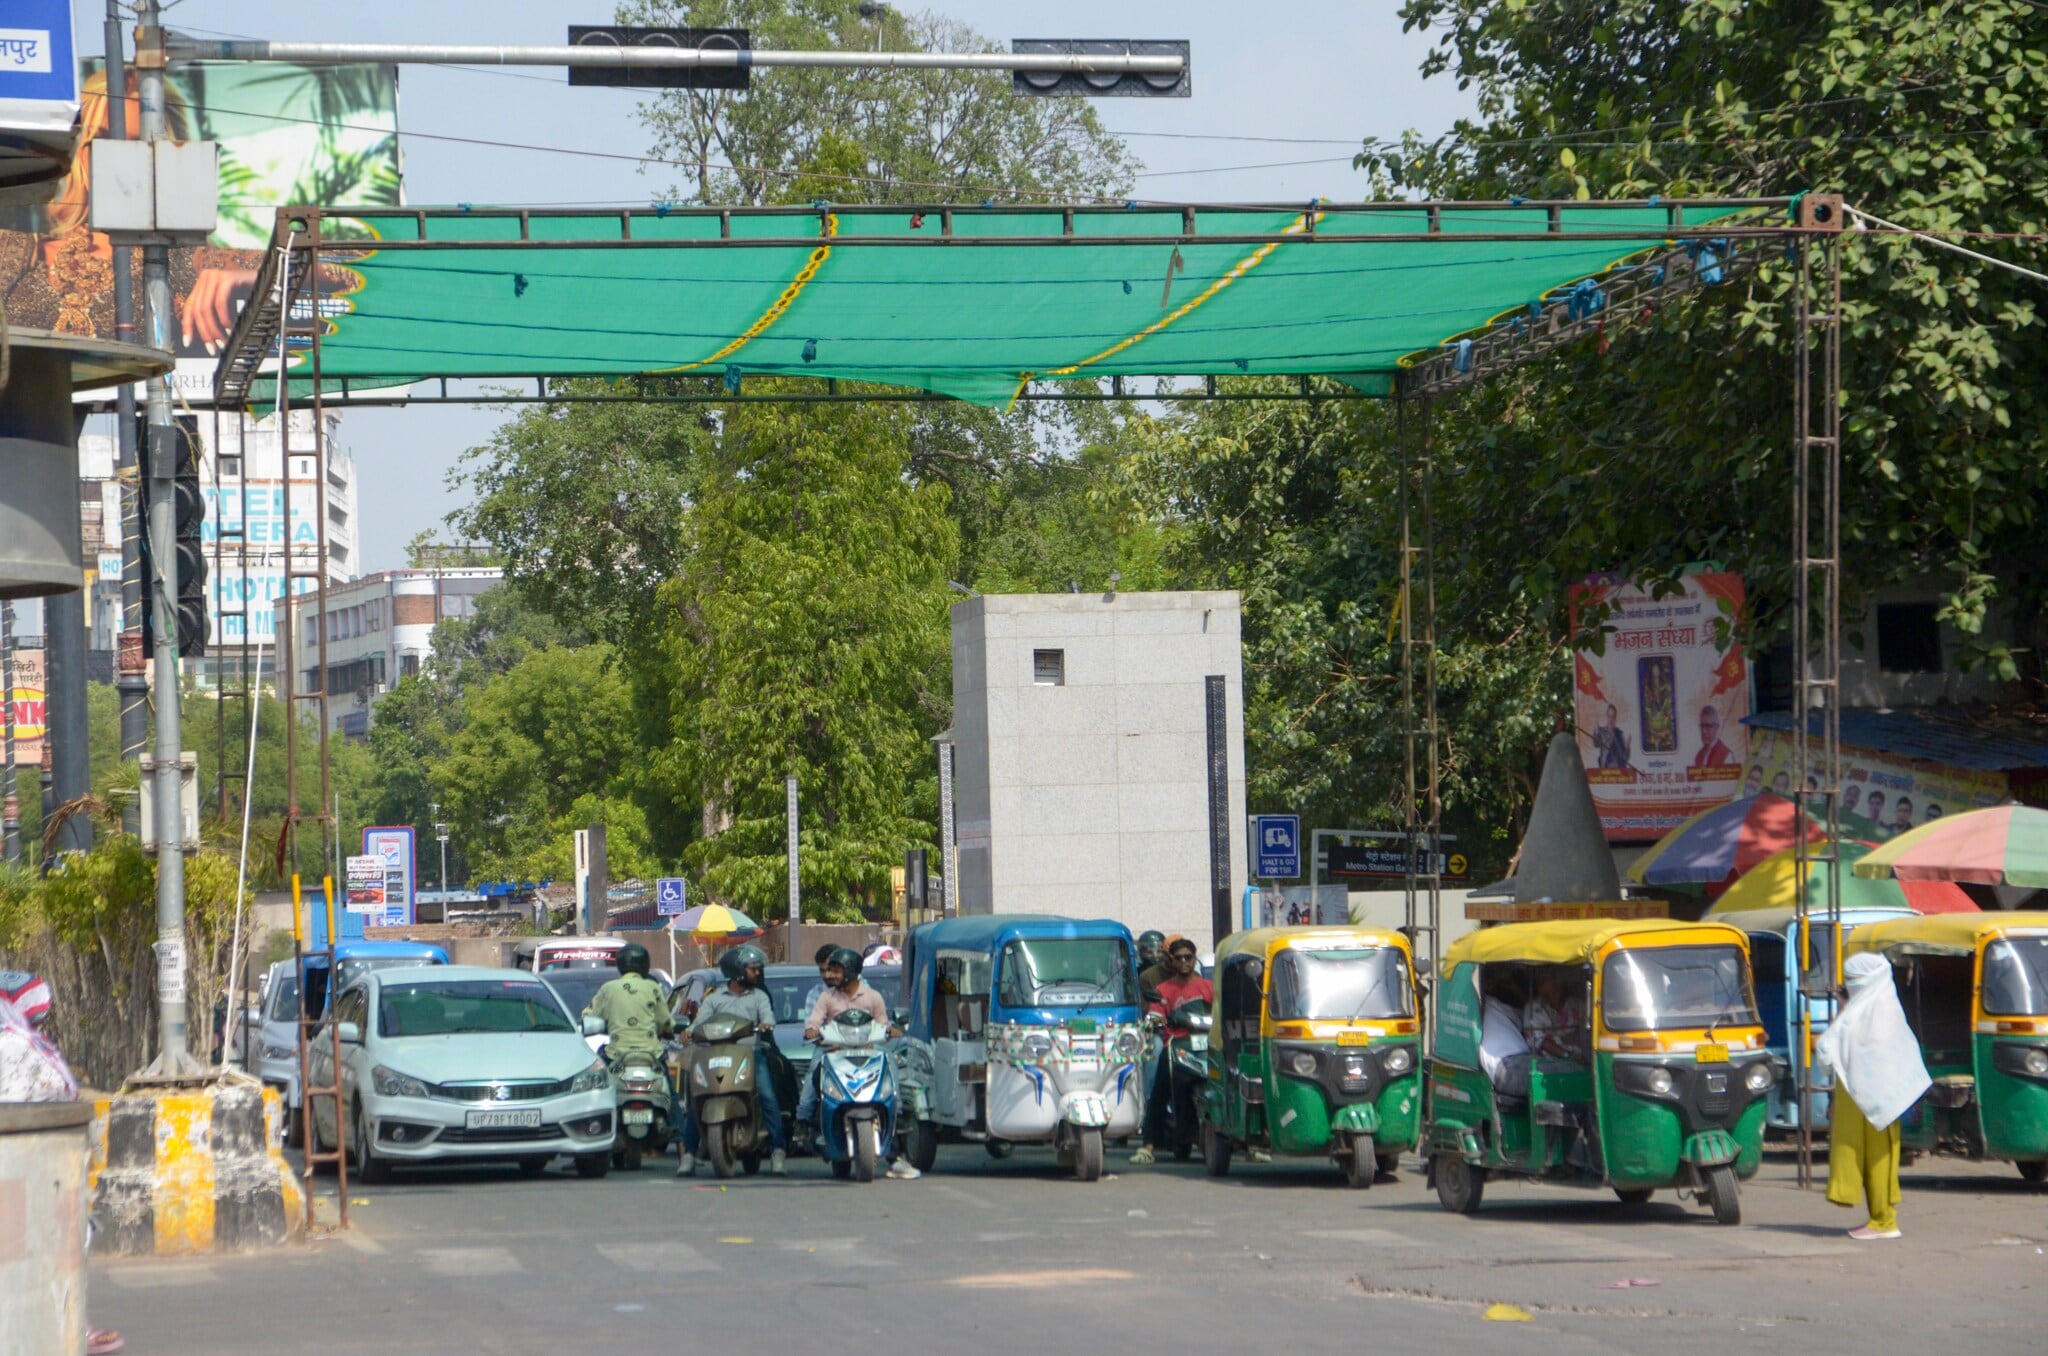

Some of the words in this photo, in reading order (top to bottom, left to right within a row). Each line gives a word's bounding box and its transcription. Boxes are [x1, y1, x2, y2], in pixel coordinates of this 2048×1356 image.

[206, 488, 299, 516] TEL
[1614, 630, 1653, 649] भजन
[1657, 621, 1697, 648] संध्या
[1345, 861, 1368, 871] Metro
[1368, 862, 1394, 872] Station
